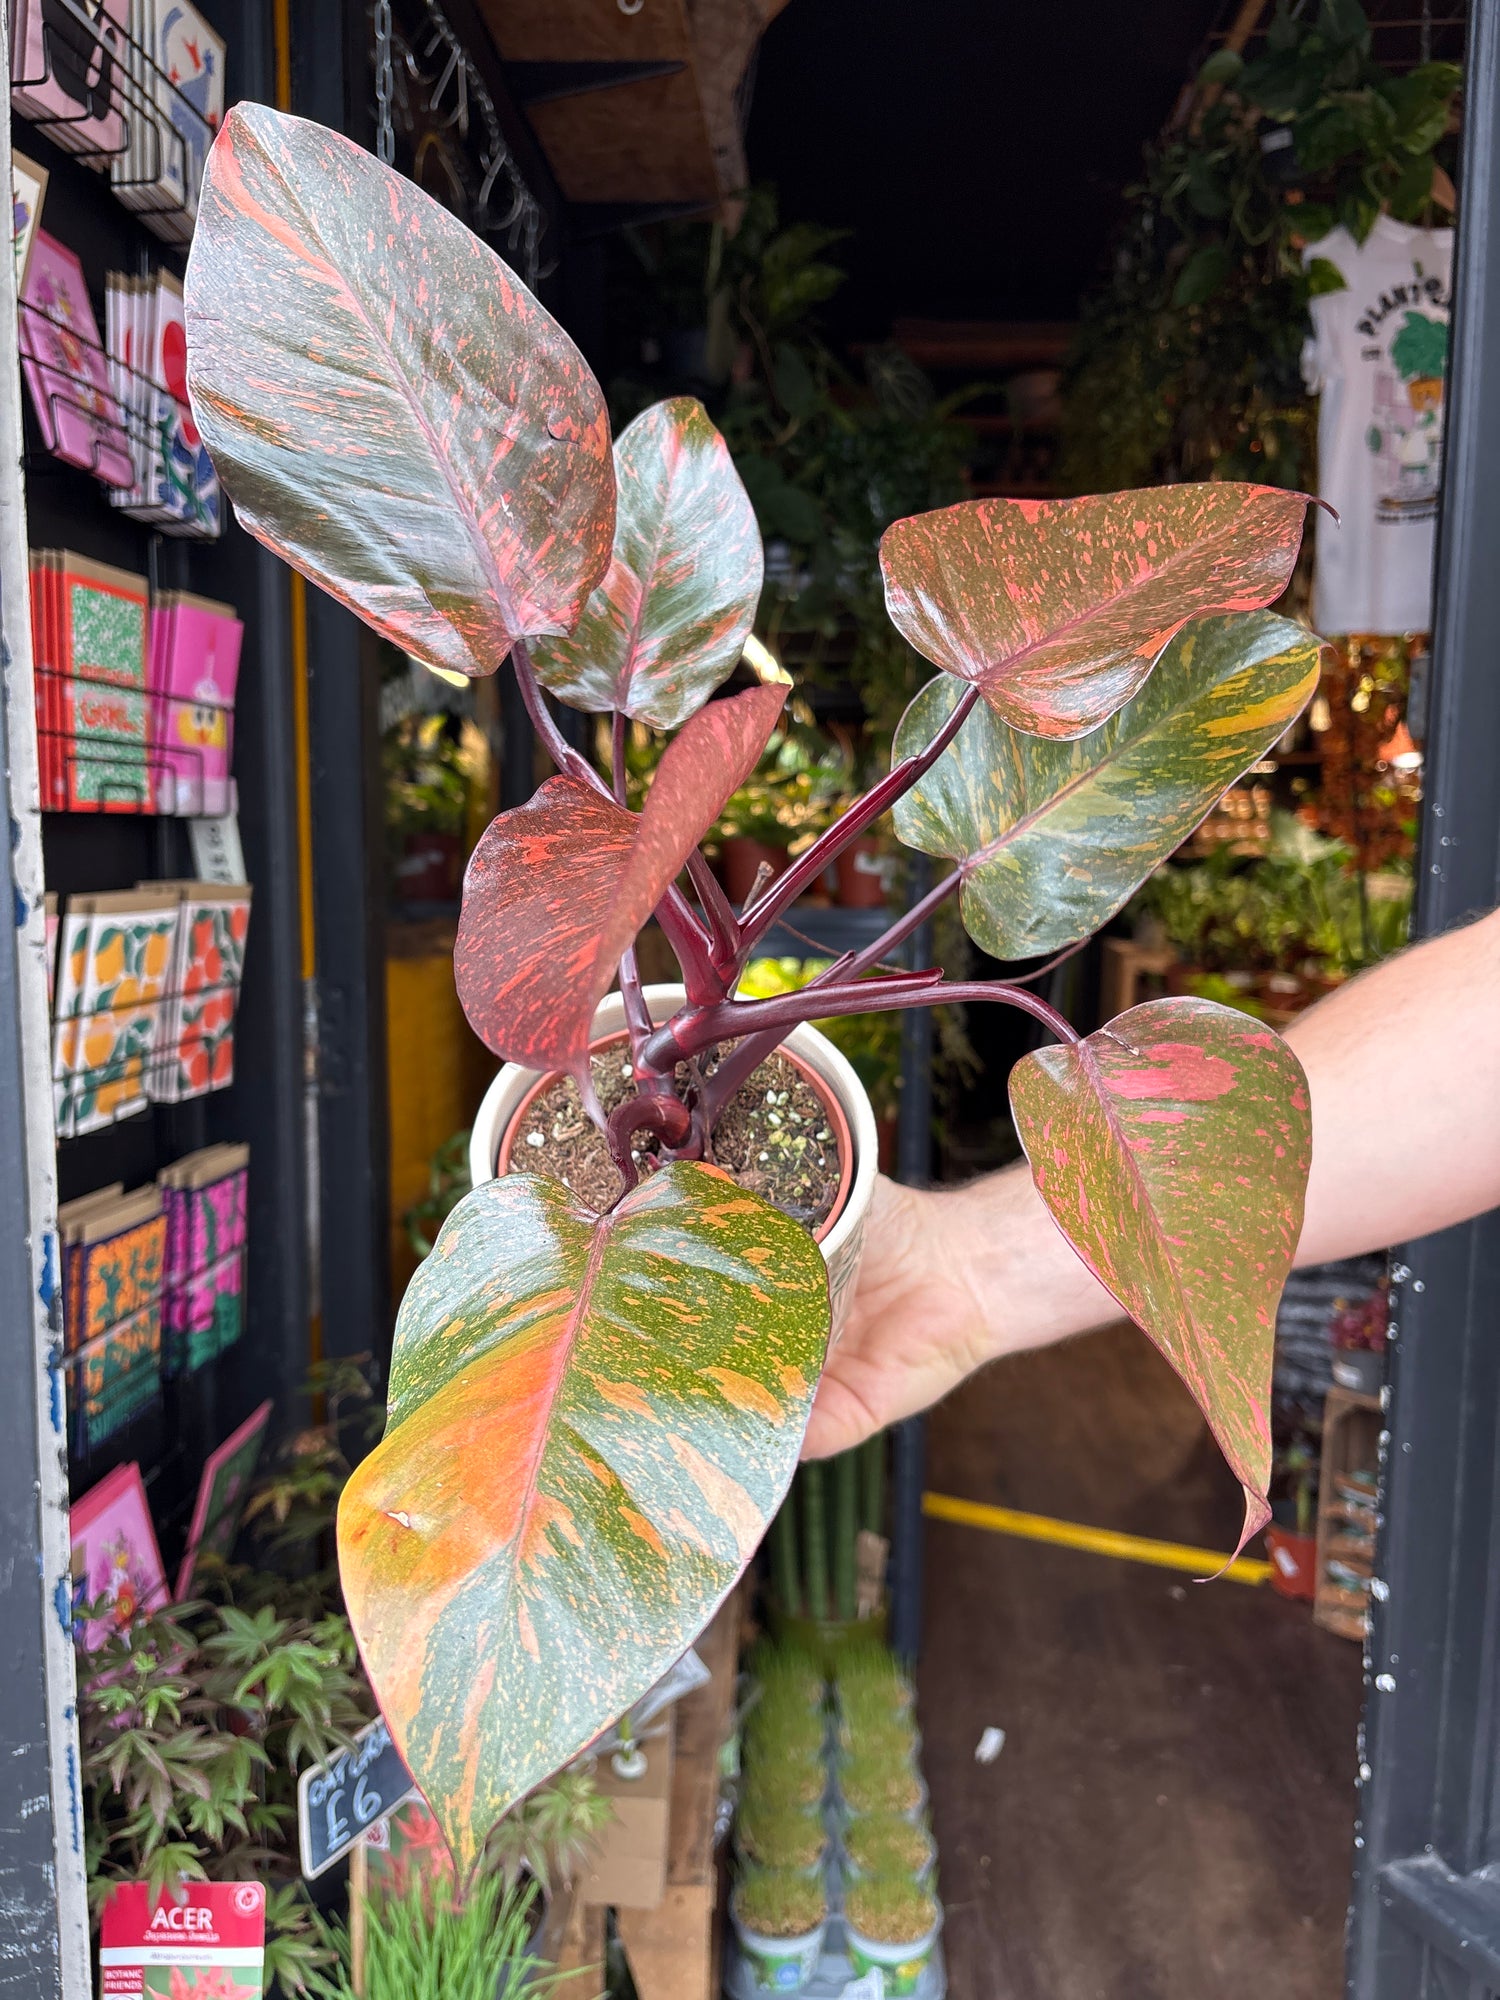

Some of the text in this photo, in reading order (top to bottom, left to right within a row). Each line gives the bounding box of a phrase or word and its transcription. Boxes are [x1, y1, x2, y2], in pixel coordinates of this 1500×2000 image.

[326, 1773, 382, 1852] £6
[150, 1906, 213, 1930] ACER
[104, 1980, 143, 1990] FRIENDS
